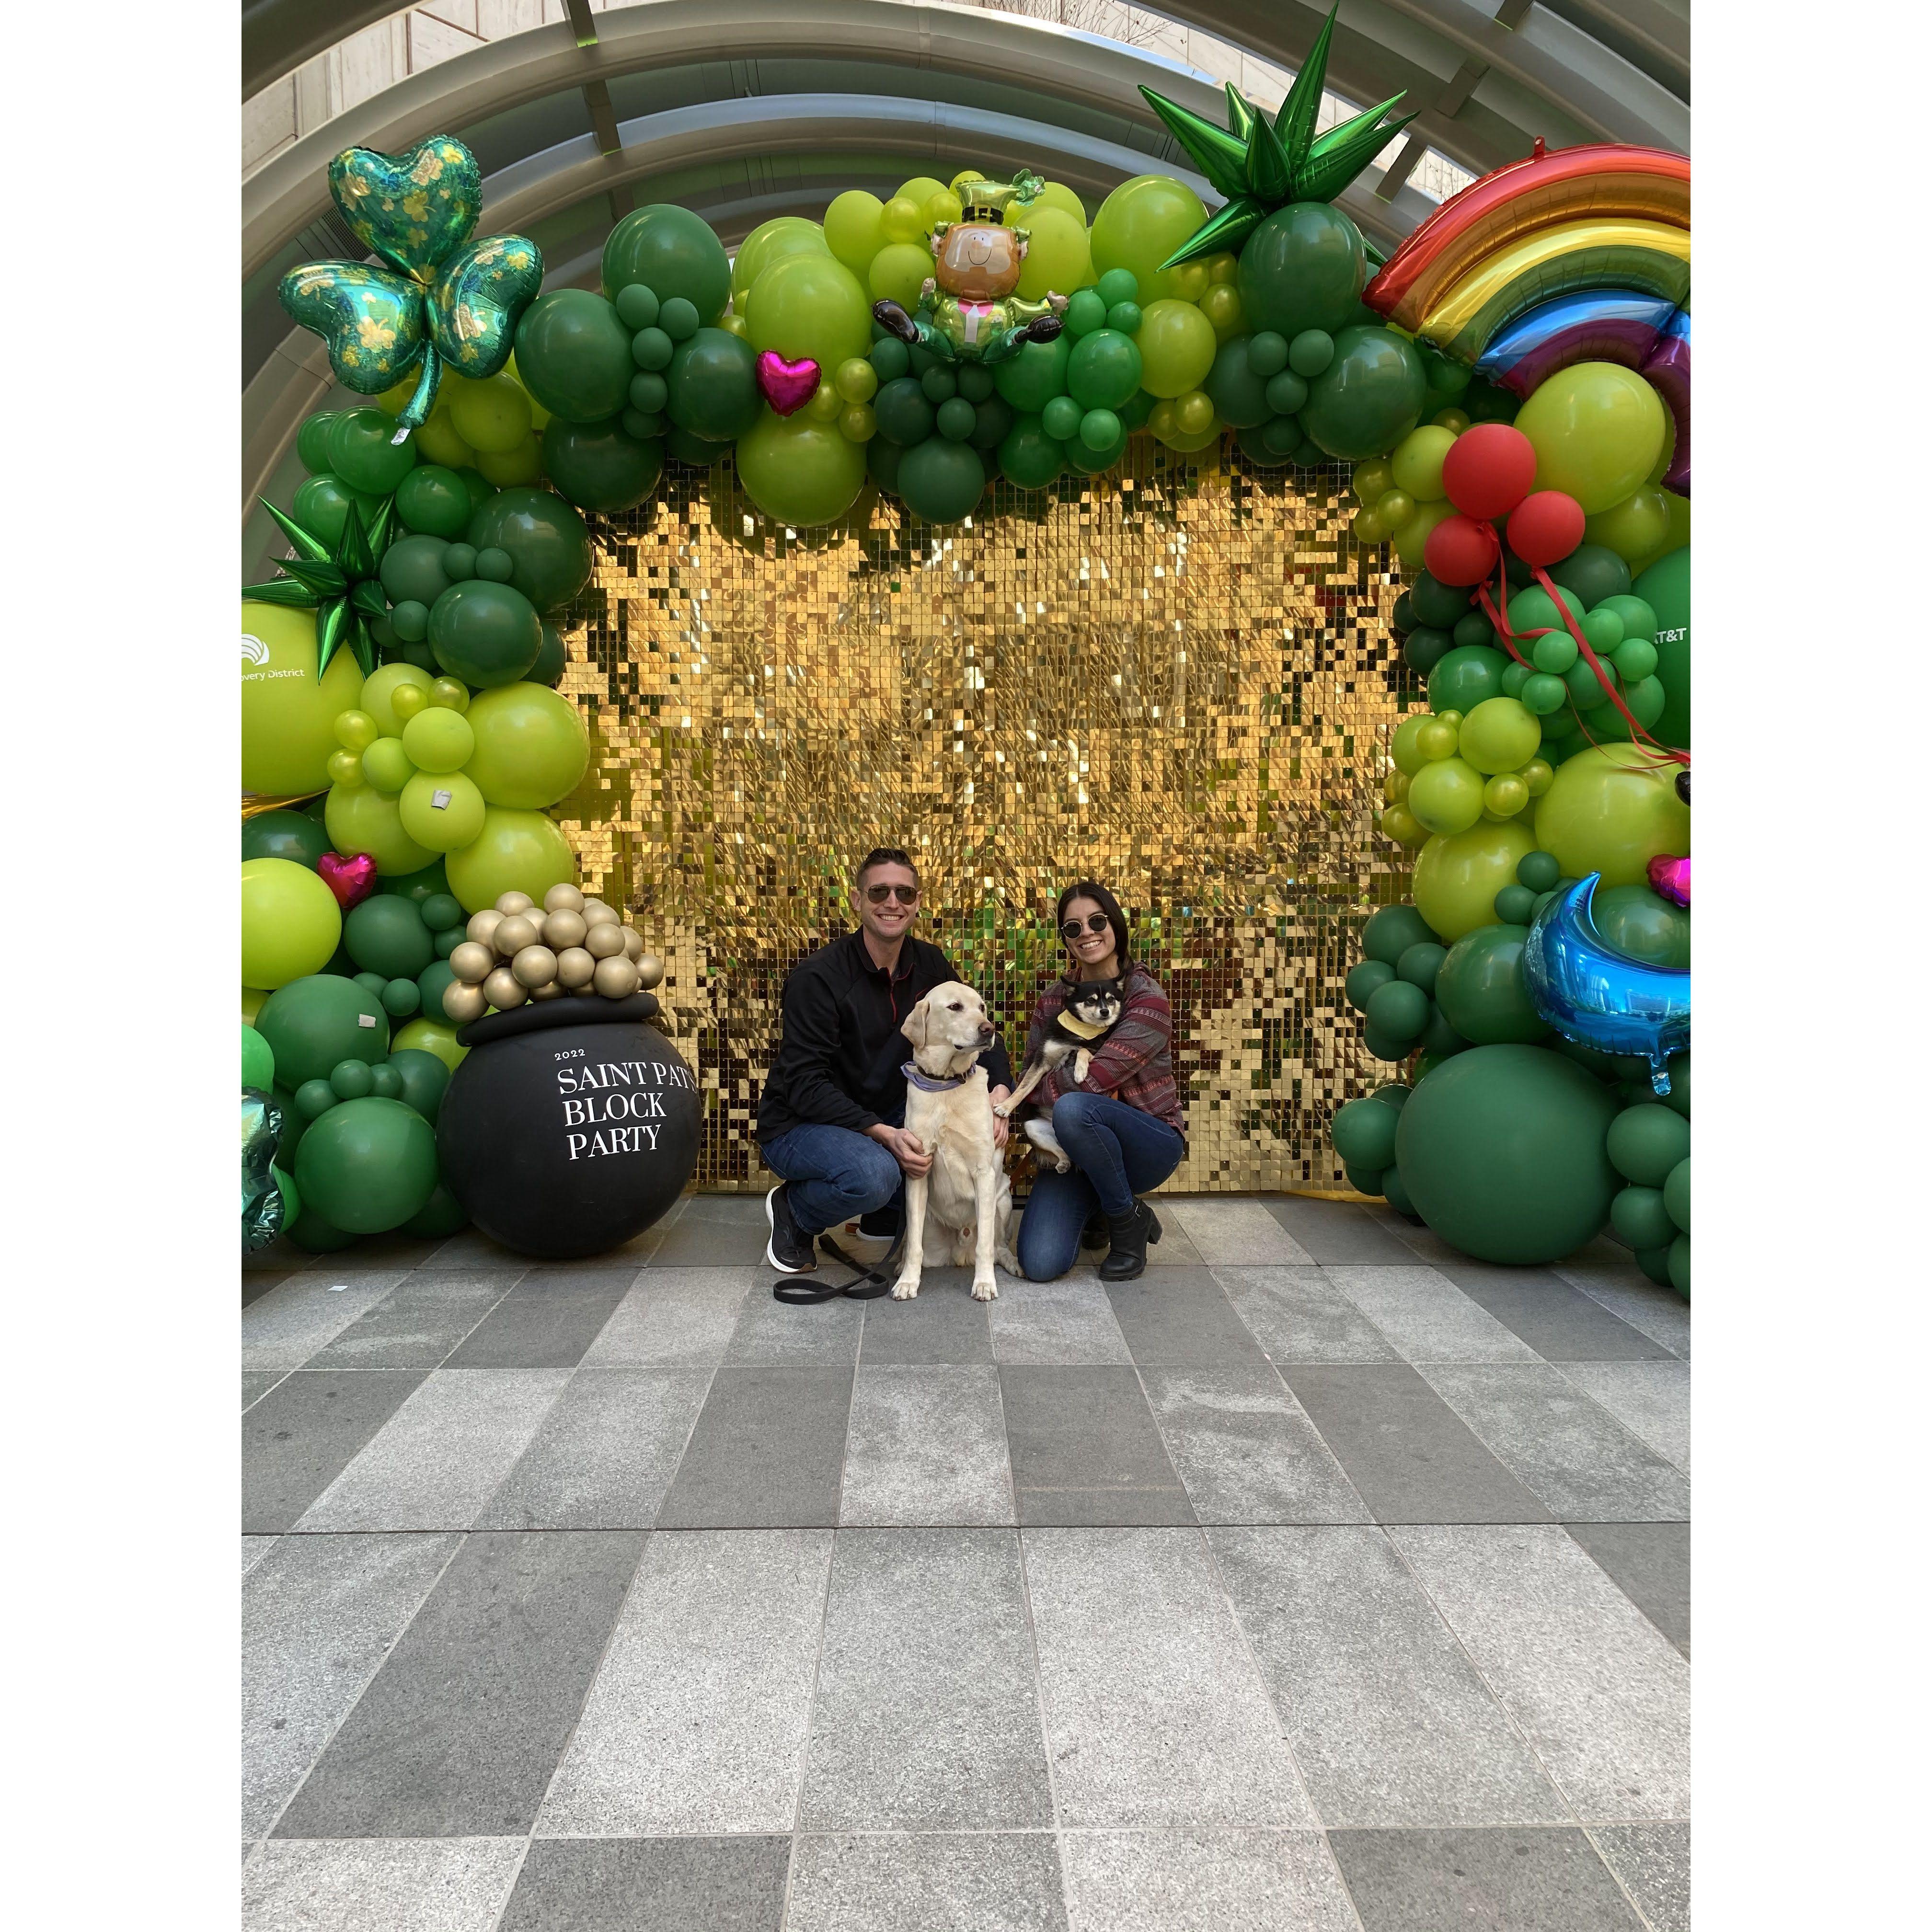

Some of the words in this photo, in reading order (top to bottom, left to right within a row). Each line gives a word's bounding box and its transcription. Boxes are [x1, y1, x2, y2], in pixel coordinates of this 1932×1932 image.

[268, 668, 305, 678] District
[554, 1048, 586, 1061] 2022
[557, 1062, 647, 1094] SAINT
[562, 1092, 667, 1127] BLOCK
[566, 1124, 661, 1160] PARTY
